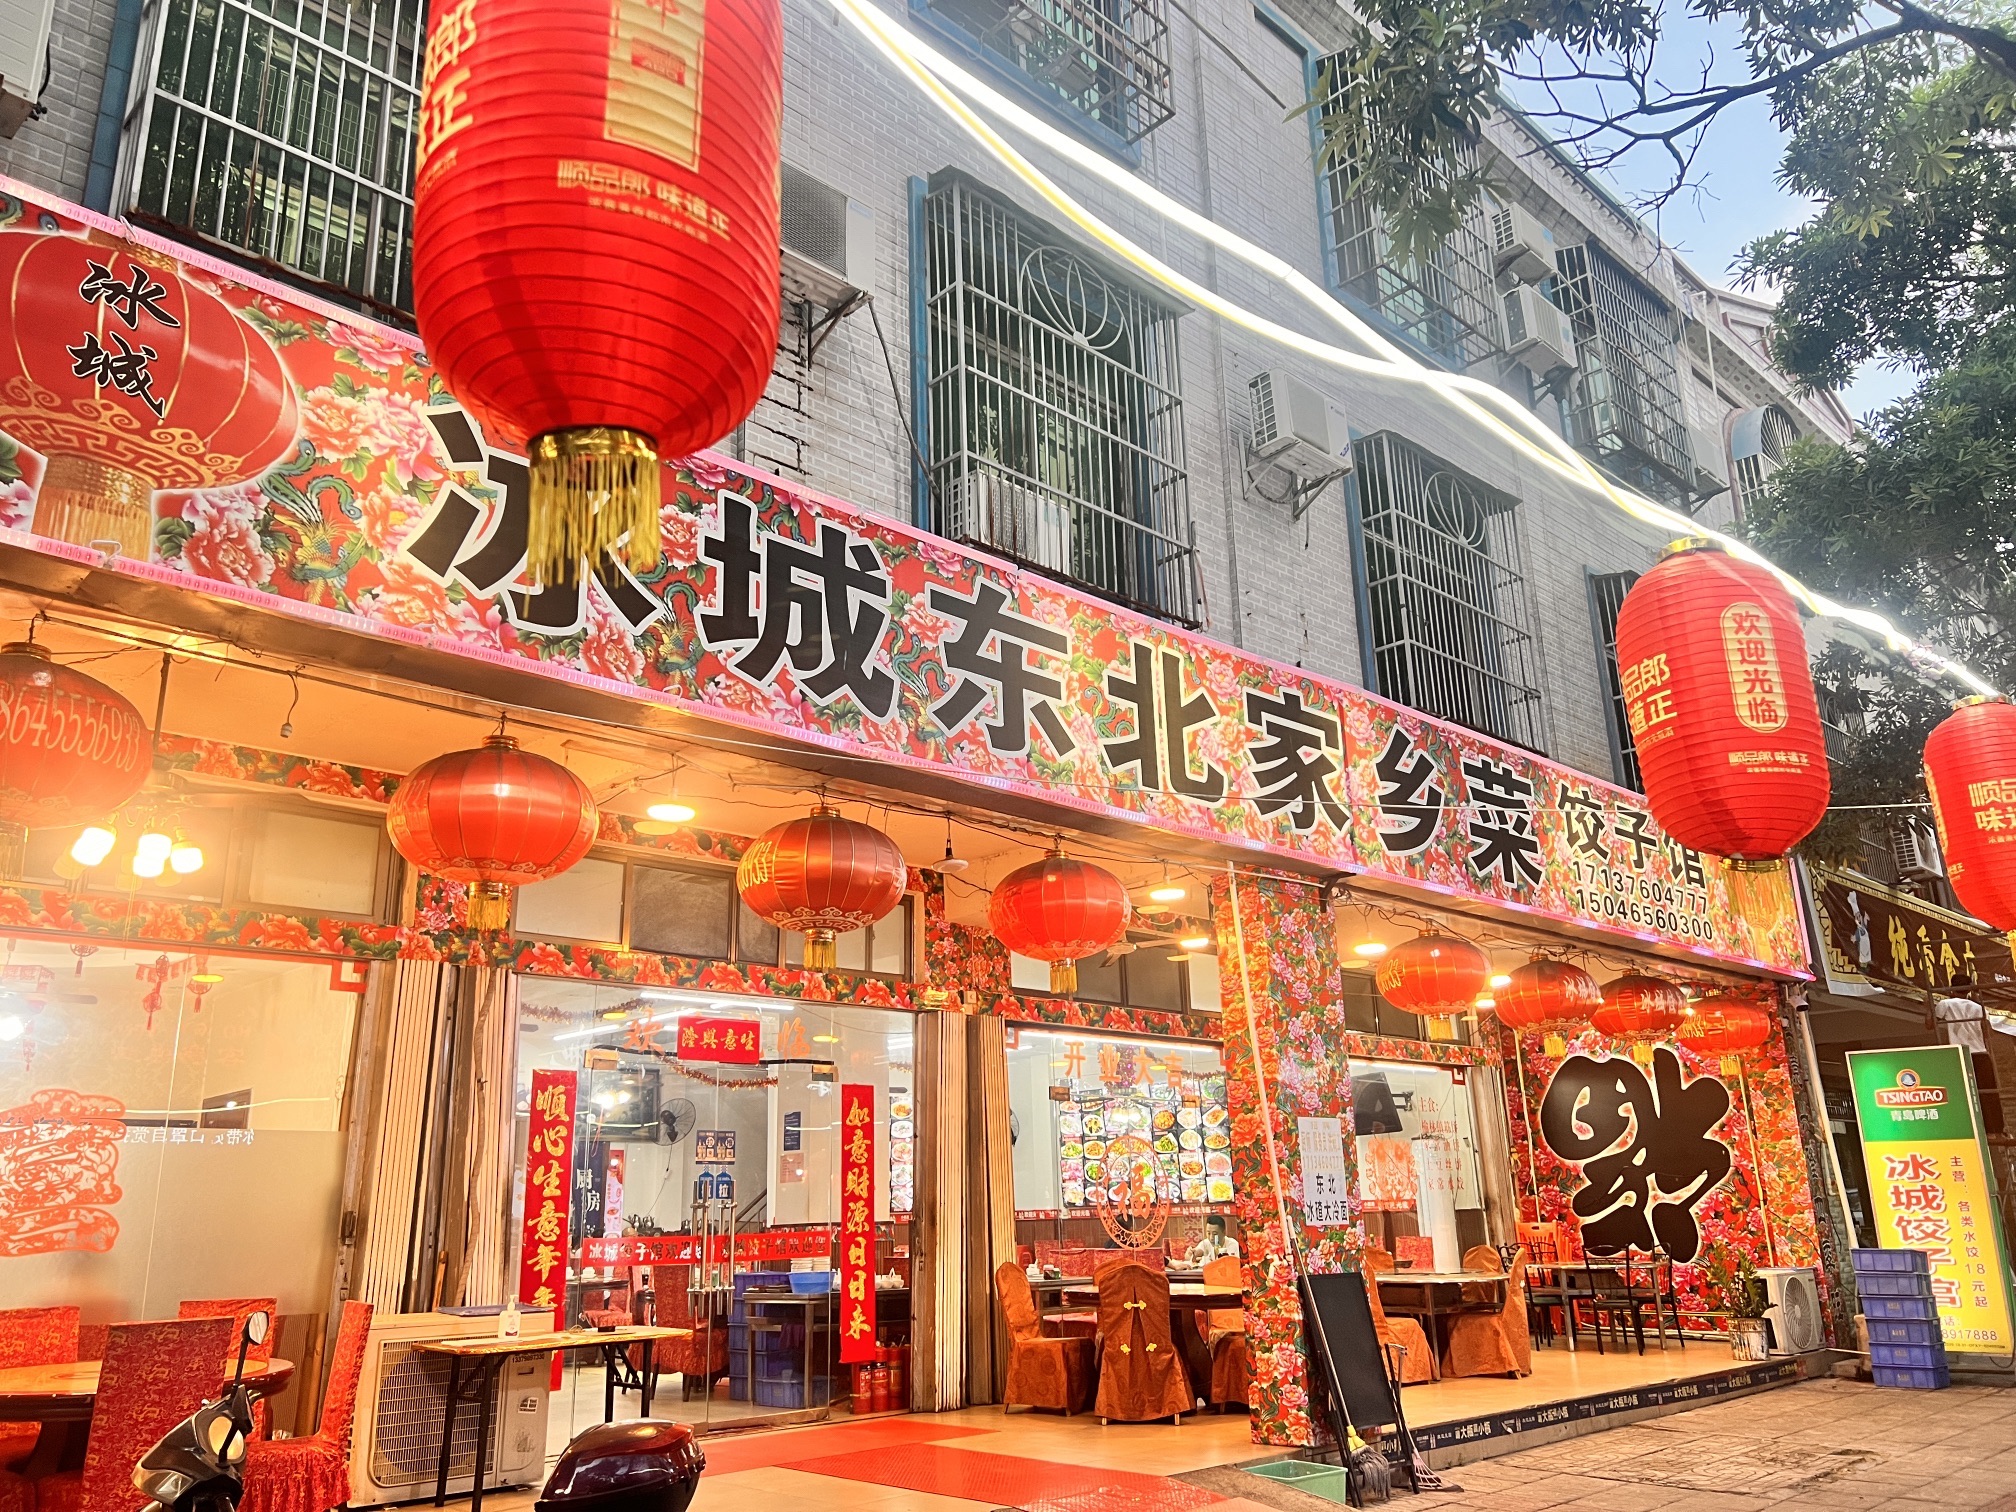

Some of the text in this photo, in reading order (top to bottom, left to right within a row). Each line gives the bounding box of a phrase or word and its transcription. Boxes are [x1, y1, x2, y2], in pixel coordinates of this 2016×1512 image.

[557, 160, 651, 199] 顺品郎
[67, 261, 181, 419] 冰城
[408, 409, 1706, 890] 冰城东北家乡菜 饺子馆
[1731, 610, 1780, 726] 欢迎光临
[1728, 751, 1810, 767] 顺品郎 味道正
[1573, 861, 1707, 914] 17137604777
[1577, 889, 1713, 940] 15046560300
[1064, 1041, 1184, 1088] 开业大吉
[1880, 1090, 1943, 1104] TSINGTAO
[1891, 1109, 1939, 1121] 青岛啤酒
[575, 1168, 601, 1213] 厨房
[1316, 1173, 1336, 1195] 东北
